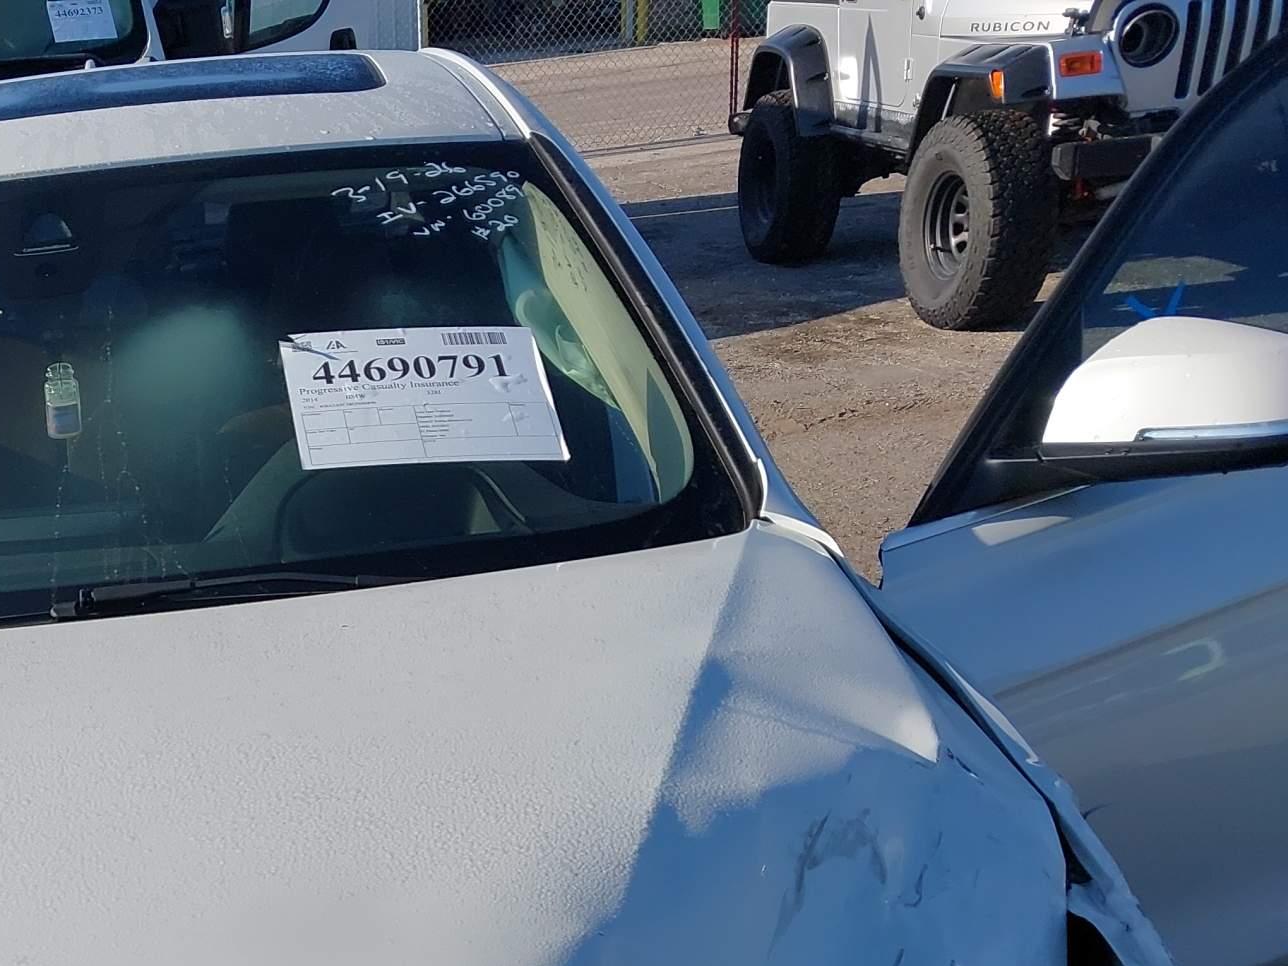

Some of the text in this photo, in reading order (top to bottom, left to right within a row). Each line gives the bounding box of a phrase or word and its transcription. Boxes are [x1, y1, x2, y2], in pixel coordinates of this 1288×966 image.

[55, 6, 104, 18] 44692373
[970, 20, 1051, 33] RUBICON
[312, 354, 511, 385] 44690791
[299, 380, 460, 397] Progressive Casualty Insurance
